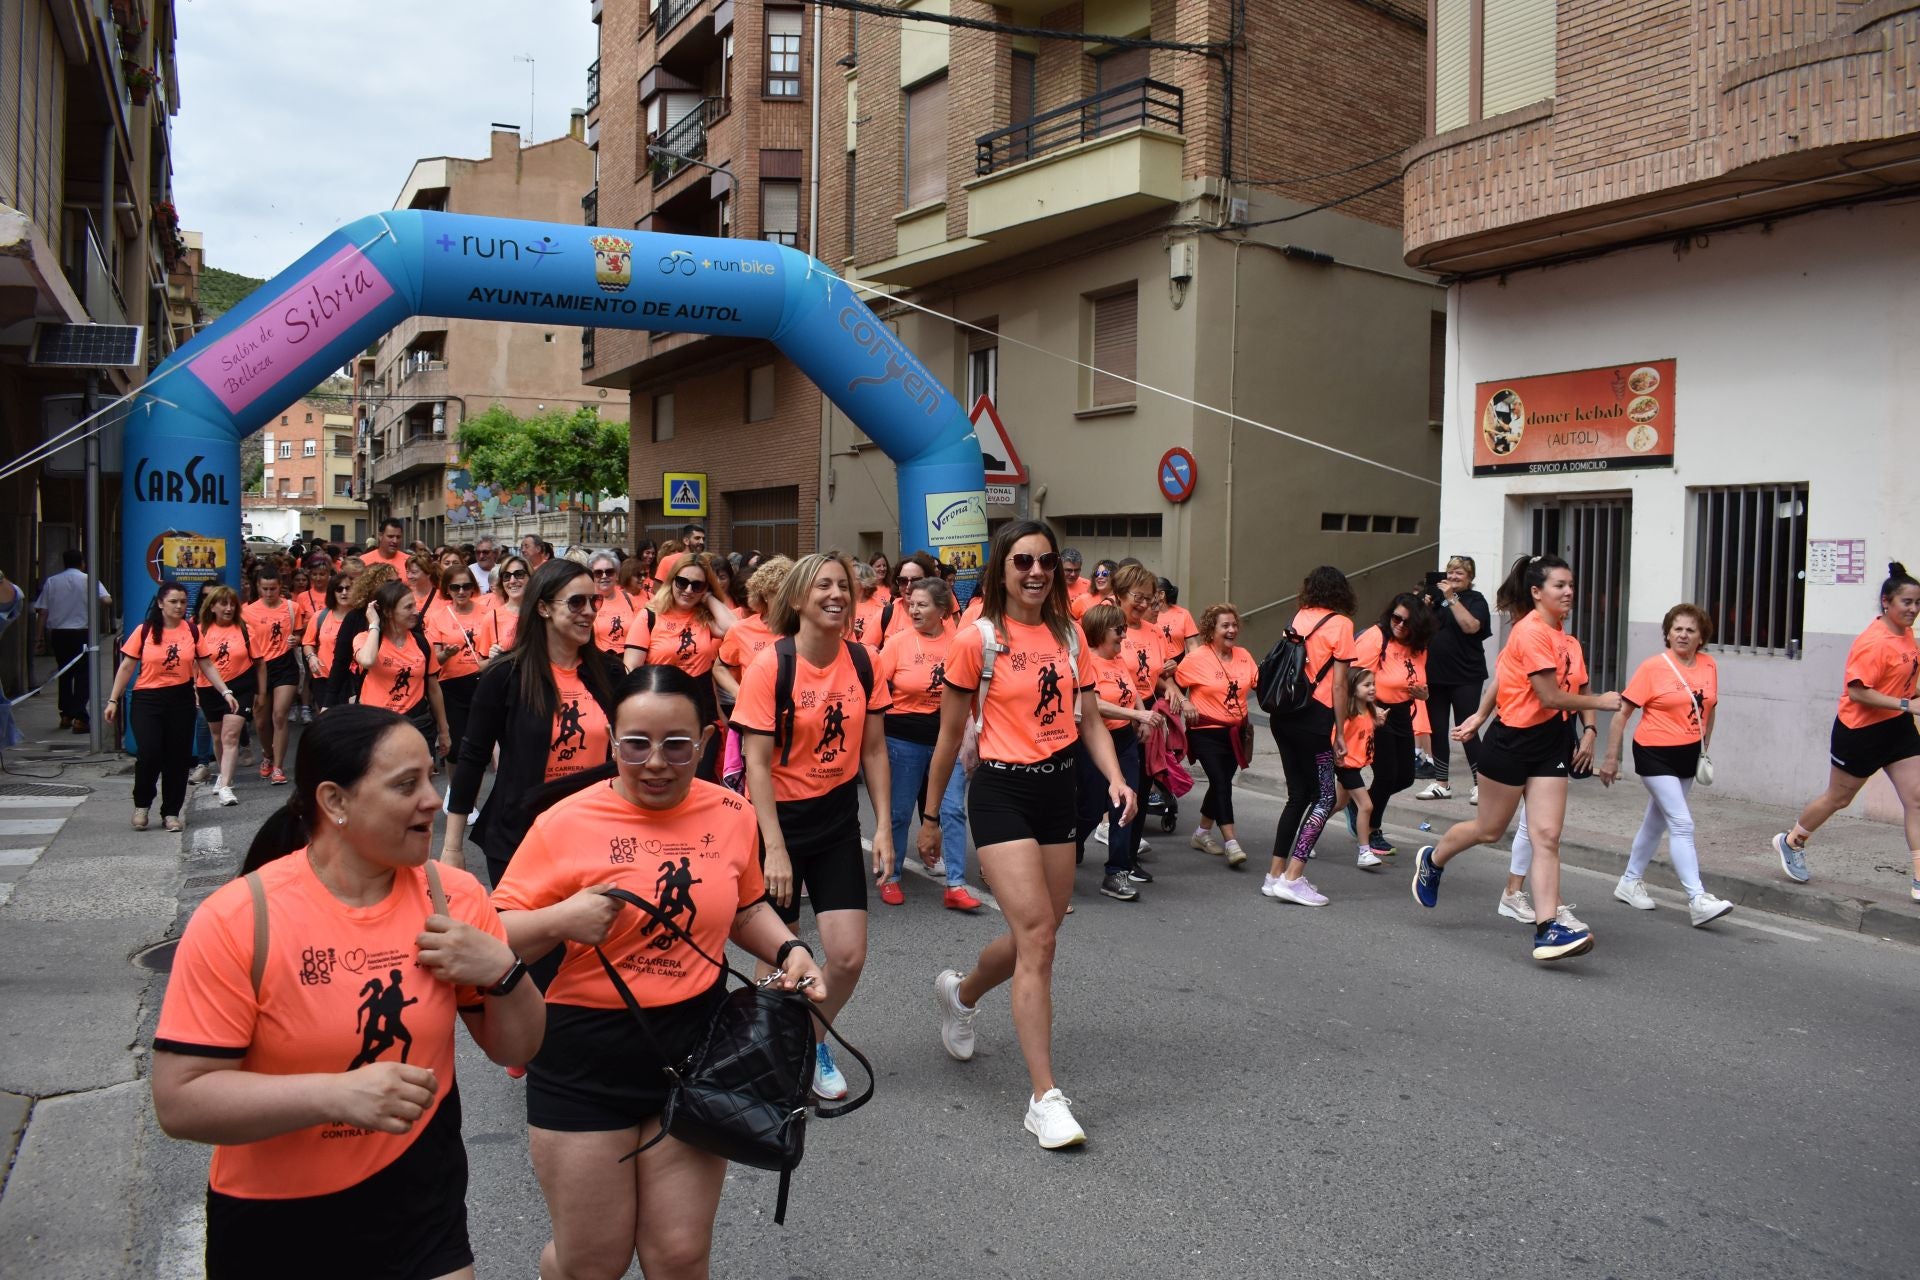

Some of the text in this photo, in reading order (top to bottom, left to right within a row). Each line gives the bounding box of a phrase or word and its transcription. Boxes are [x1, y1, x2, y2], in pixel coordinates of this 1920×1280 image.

[284, 269, 374, 344] Silvia
[467, 285, 742, 322] AYUNTAMIENTO DE AUTOL
[220, 325, 275, 372] Salón de
[223, 355, 274, 395] Belleza
[1526, 403, 1624, 426] doner kebab
[1547, 431, 1600, 449] (AUTOL)
[1529, 460, 1608, 473] SERVICIO A DOMICILIO
[931, 504, 968, 532] Verona
[1011, 763, 1055, 773] PRO
[637, 956, 682, 969] CARRERA
[646, 967, 656, 975] EL
[321, 1129, 362, 1139] CONTRA
